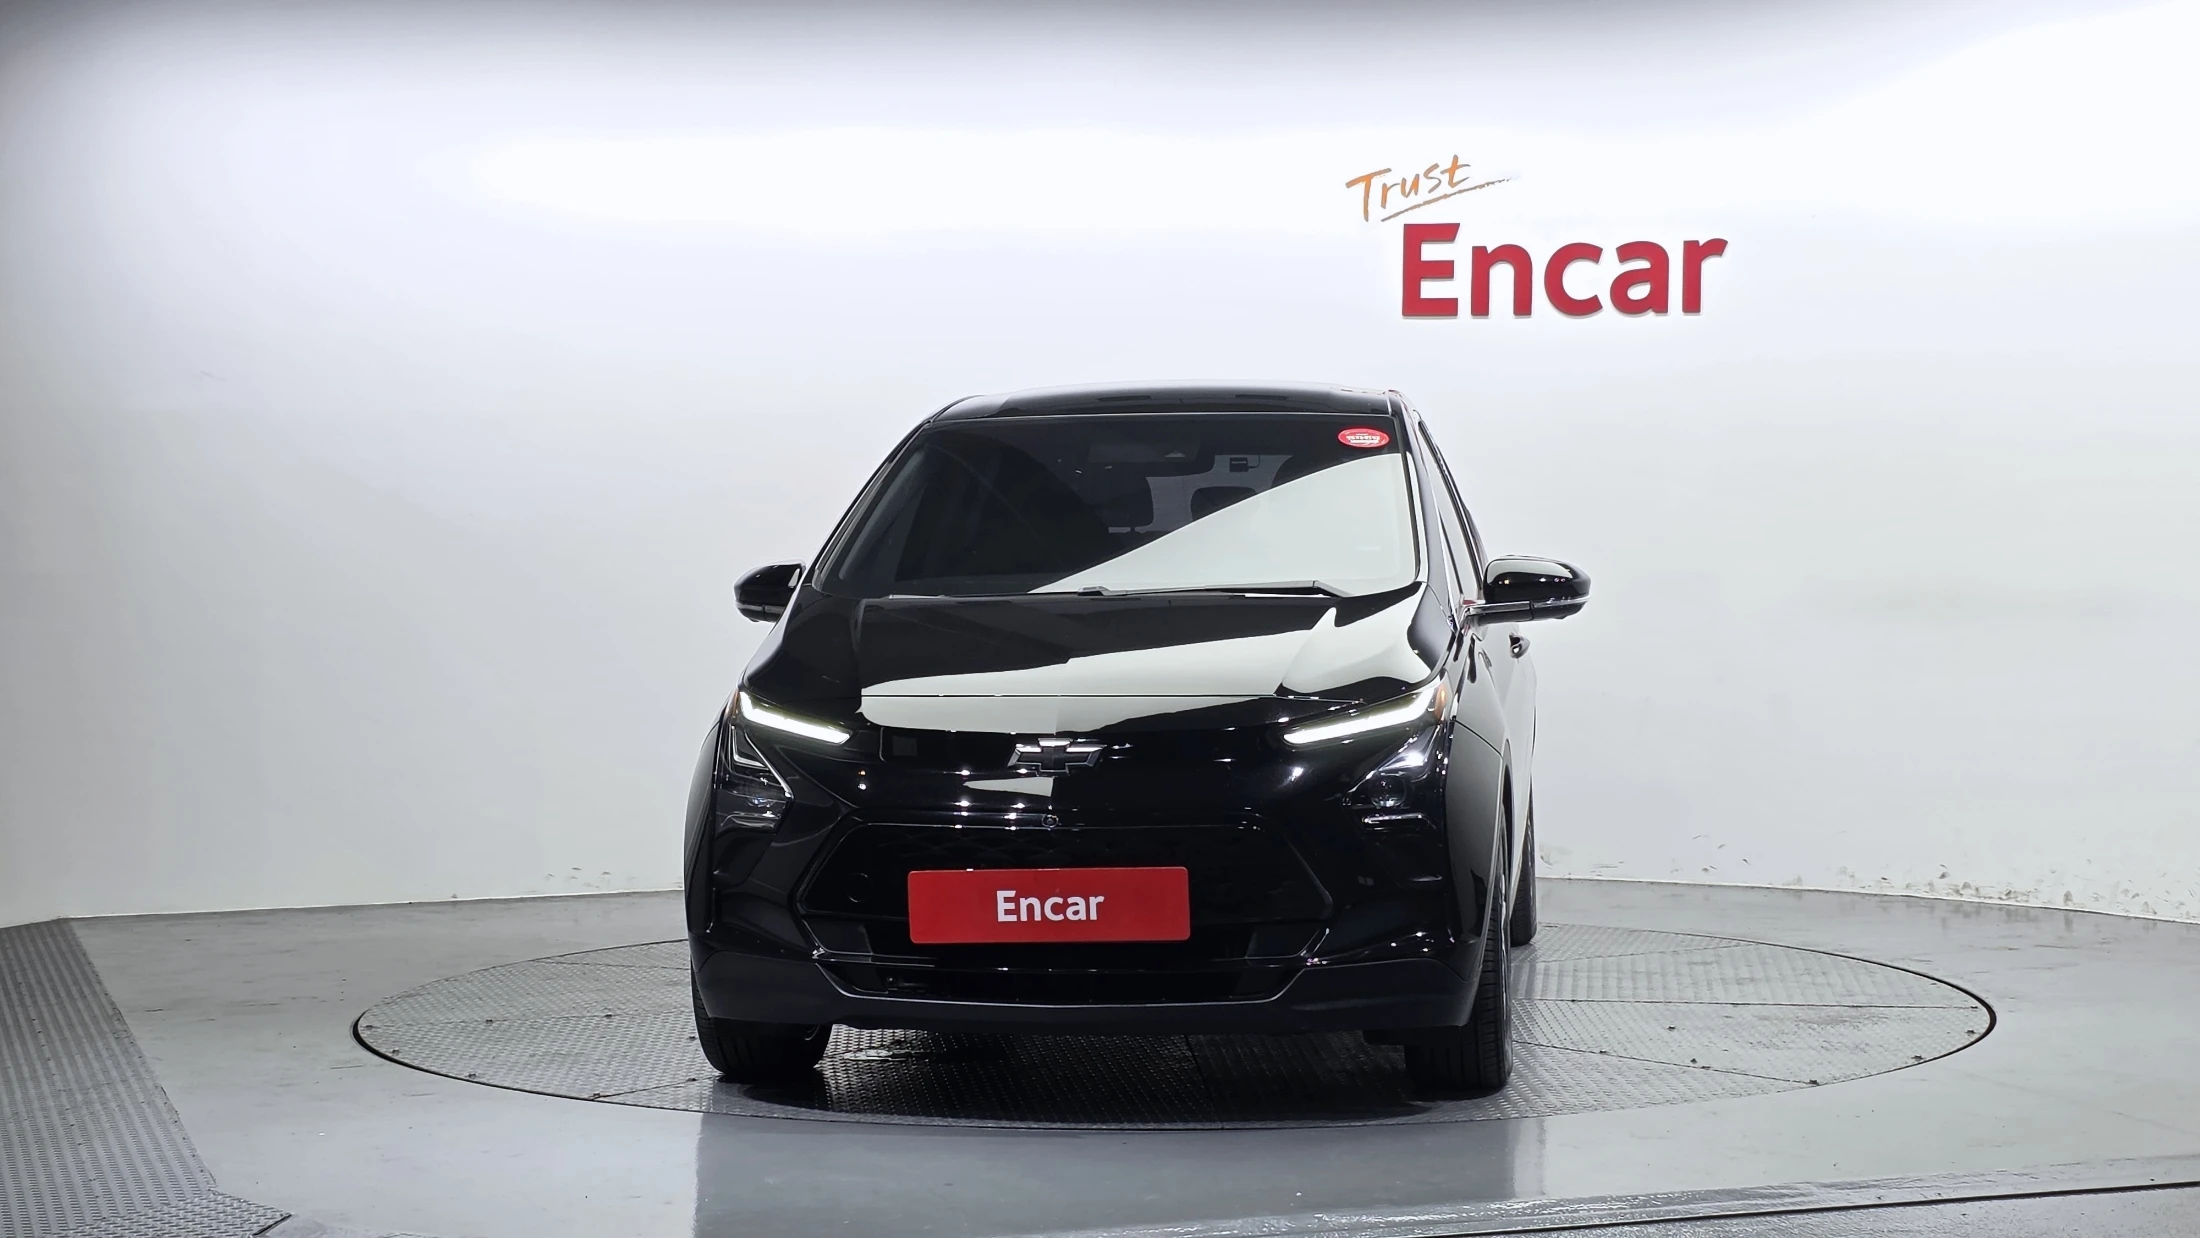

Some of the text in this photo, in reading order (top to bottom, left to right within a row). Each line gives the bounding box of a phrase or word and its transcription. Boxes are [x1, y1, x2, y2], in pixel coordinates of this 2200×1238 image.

[1345, 154, 1471, 222] Trust
[1402, 222, 1728, 318] Encar
[996, 890, 1105, 922] Encar
